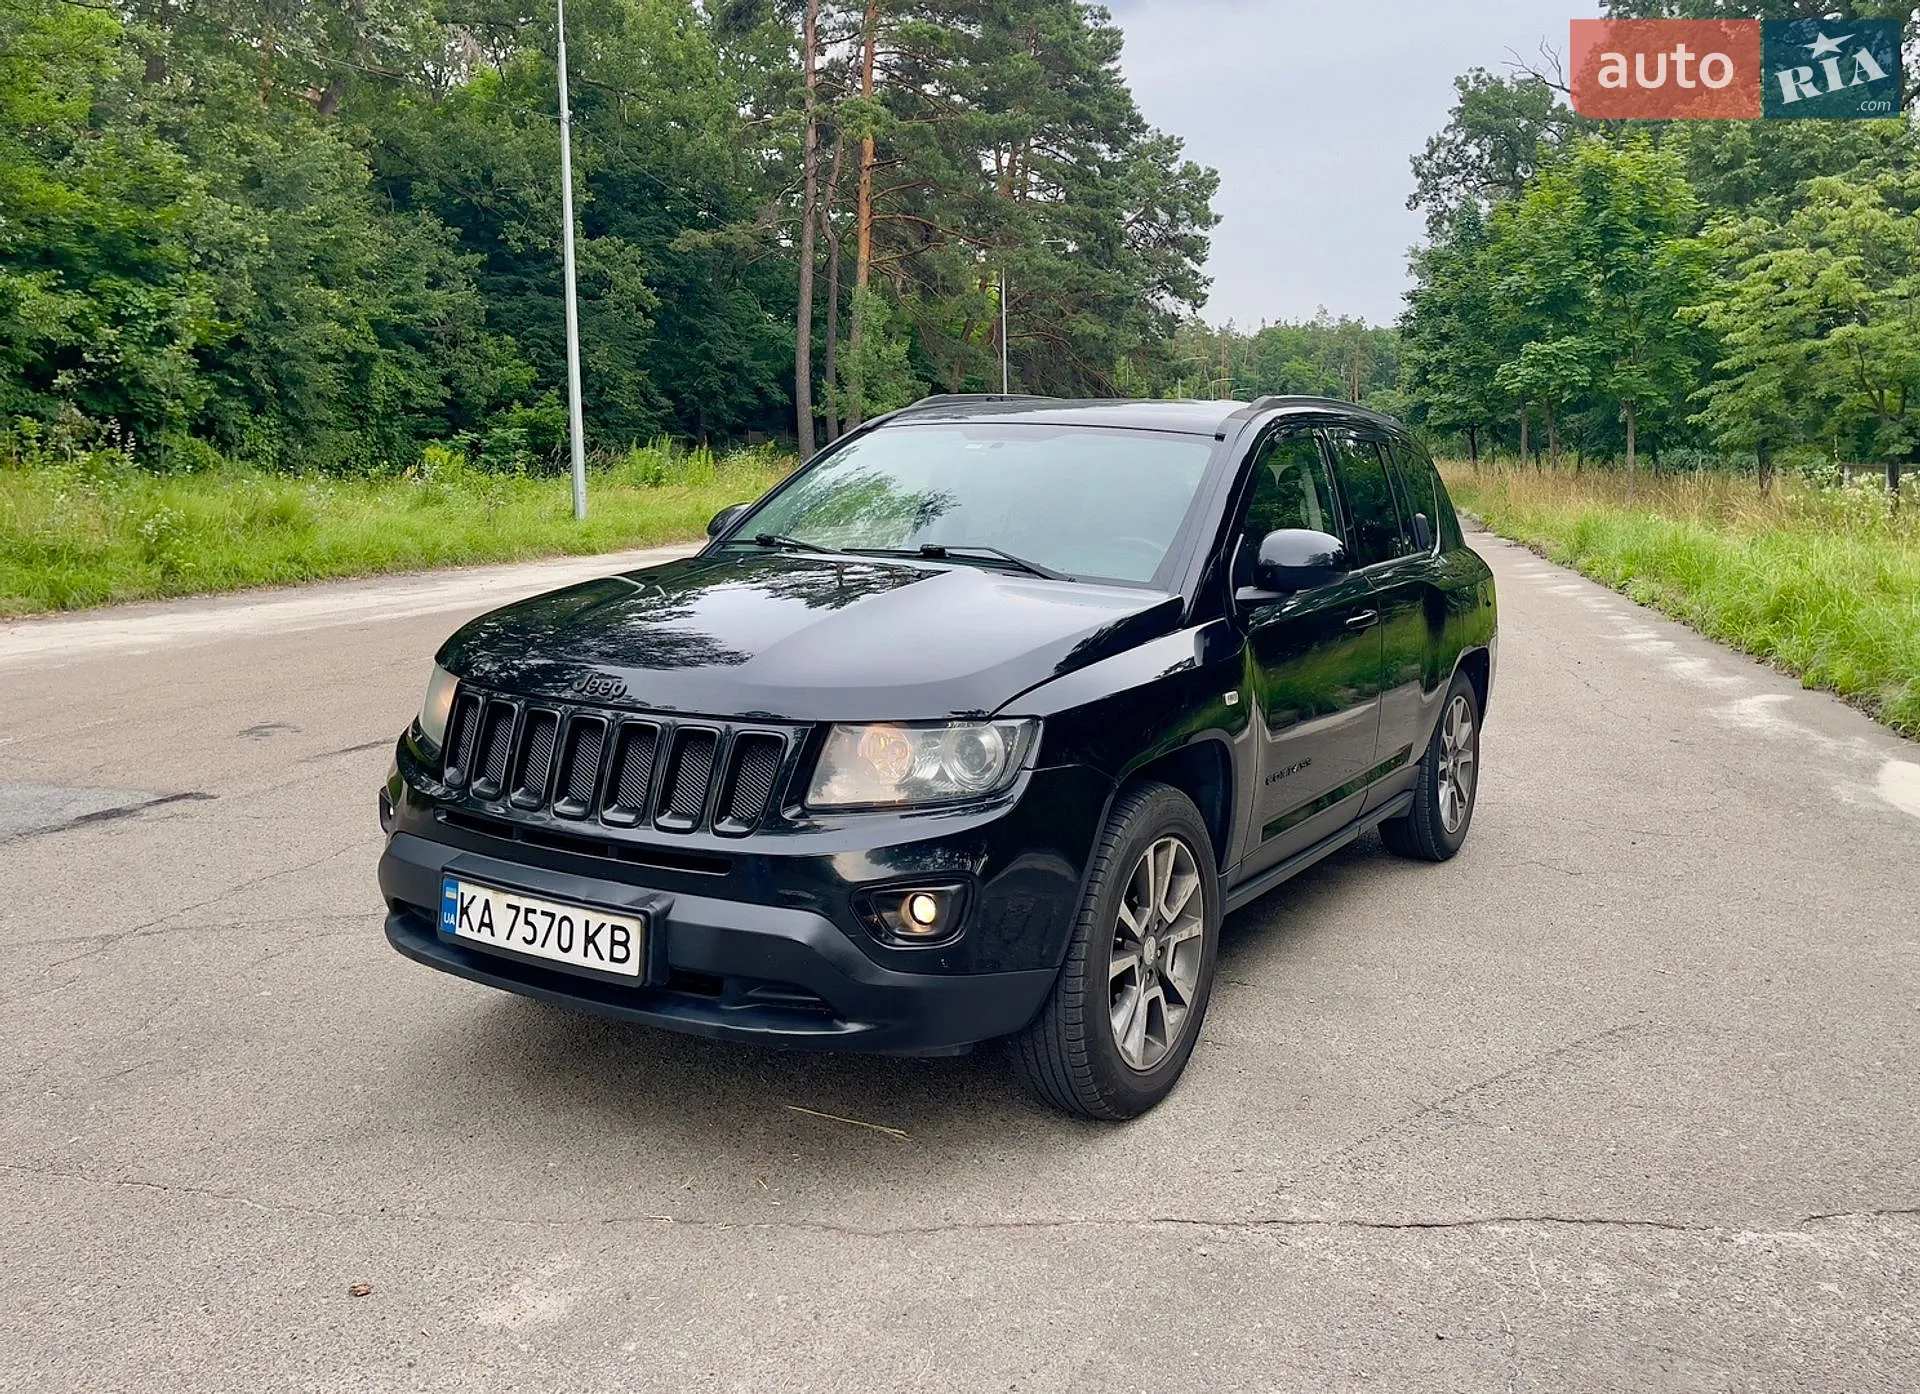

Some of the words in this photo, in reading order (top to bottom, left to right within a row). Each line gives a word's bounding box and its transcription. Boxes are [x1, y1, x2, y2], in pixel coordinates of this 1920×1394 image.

[573, 674, 628, 701] Jeep
[443, 911, 456, 926] UA
[458, 892, 495, 937] KA
[506, 903, 574, 953] 7570
[583, 920, 631, 964] KB
